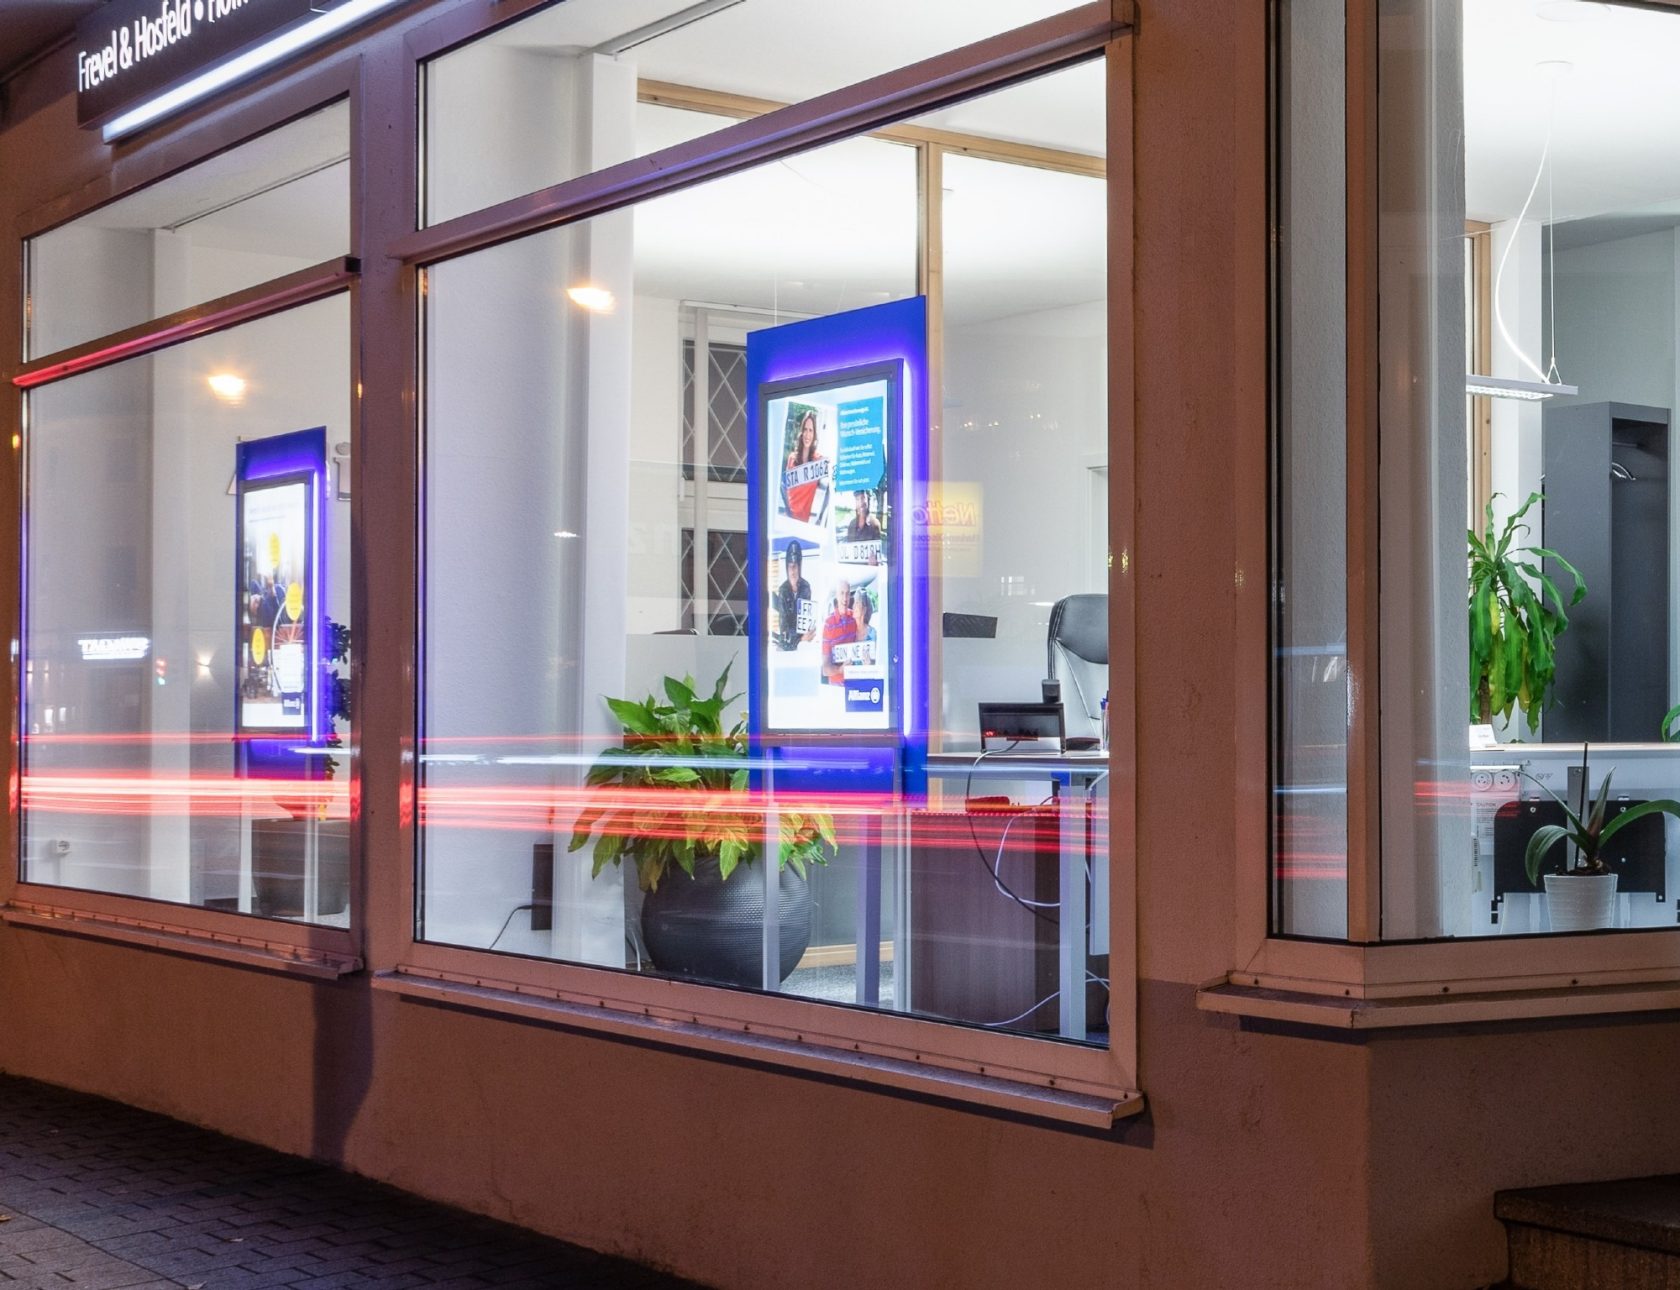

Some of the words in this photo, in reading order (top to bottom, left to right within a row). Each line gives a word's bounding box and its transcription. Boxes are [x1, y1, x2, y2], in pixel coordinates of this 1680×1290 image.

[79, 29, 117, 92] Frevel
[120, 26, 133, 69] &
[135, 0, 191, 62] Hosfeld
